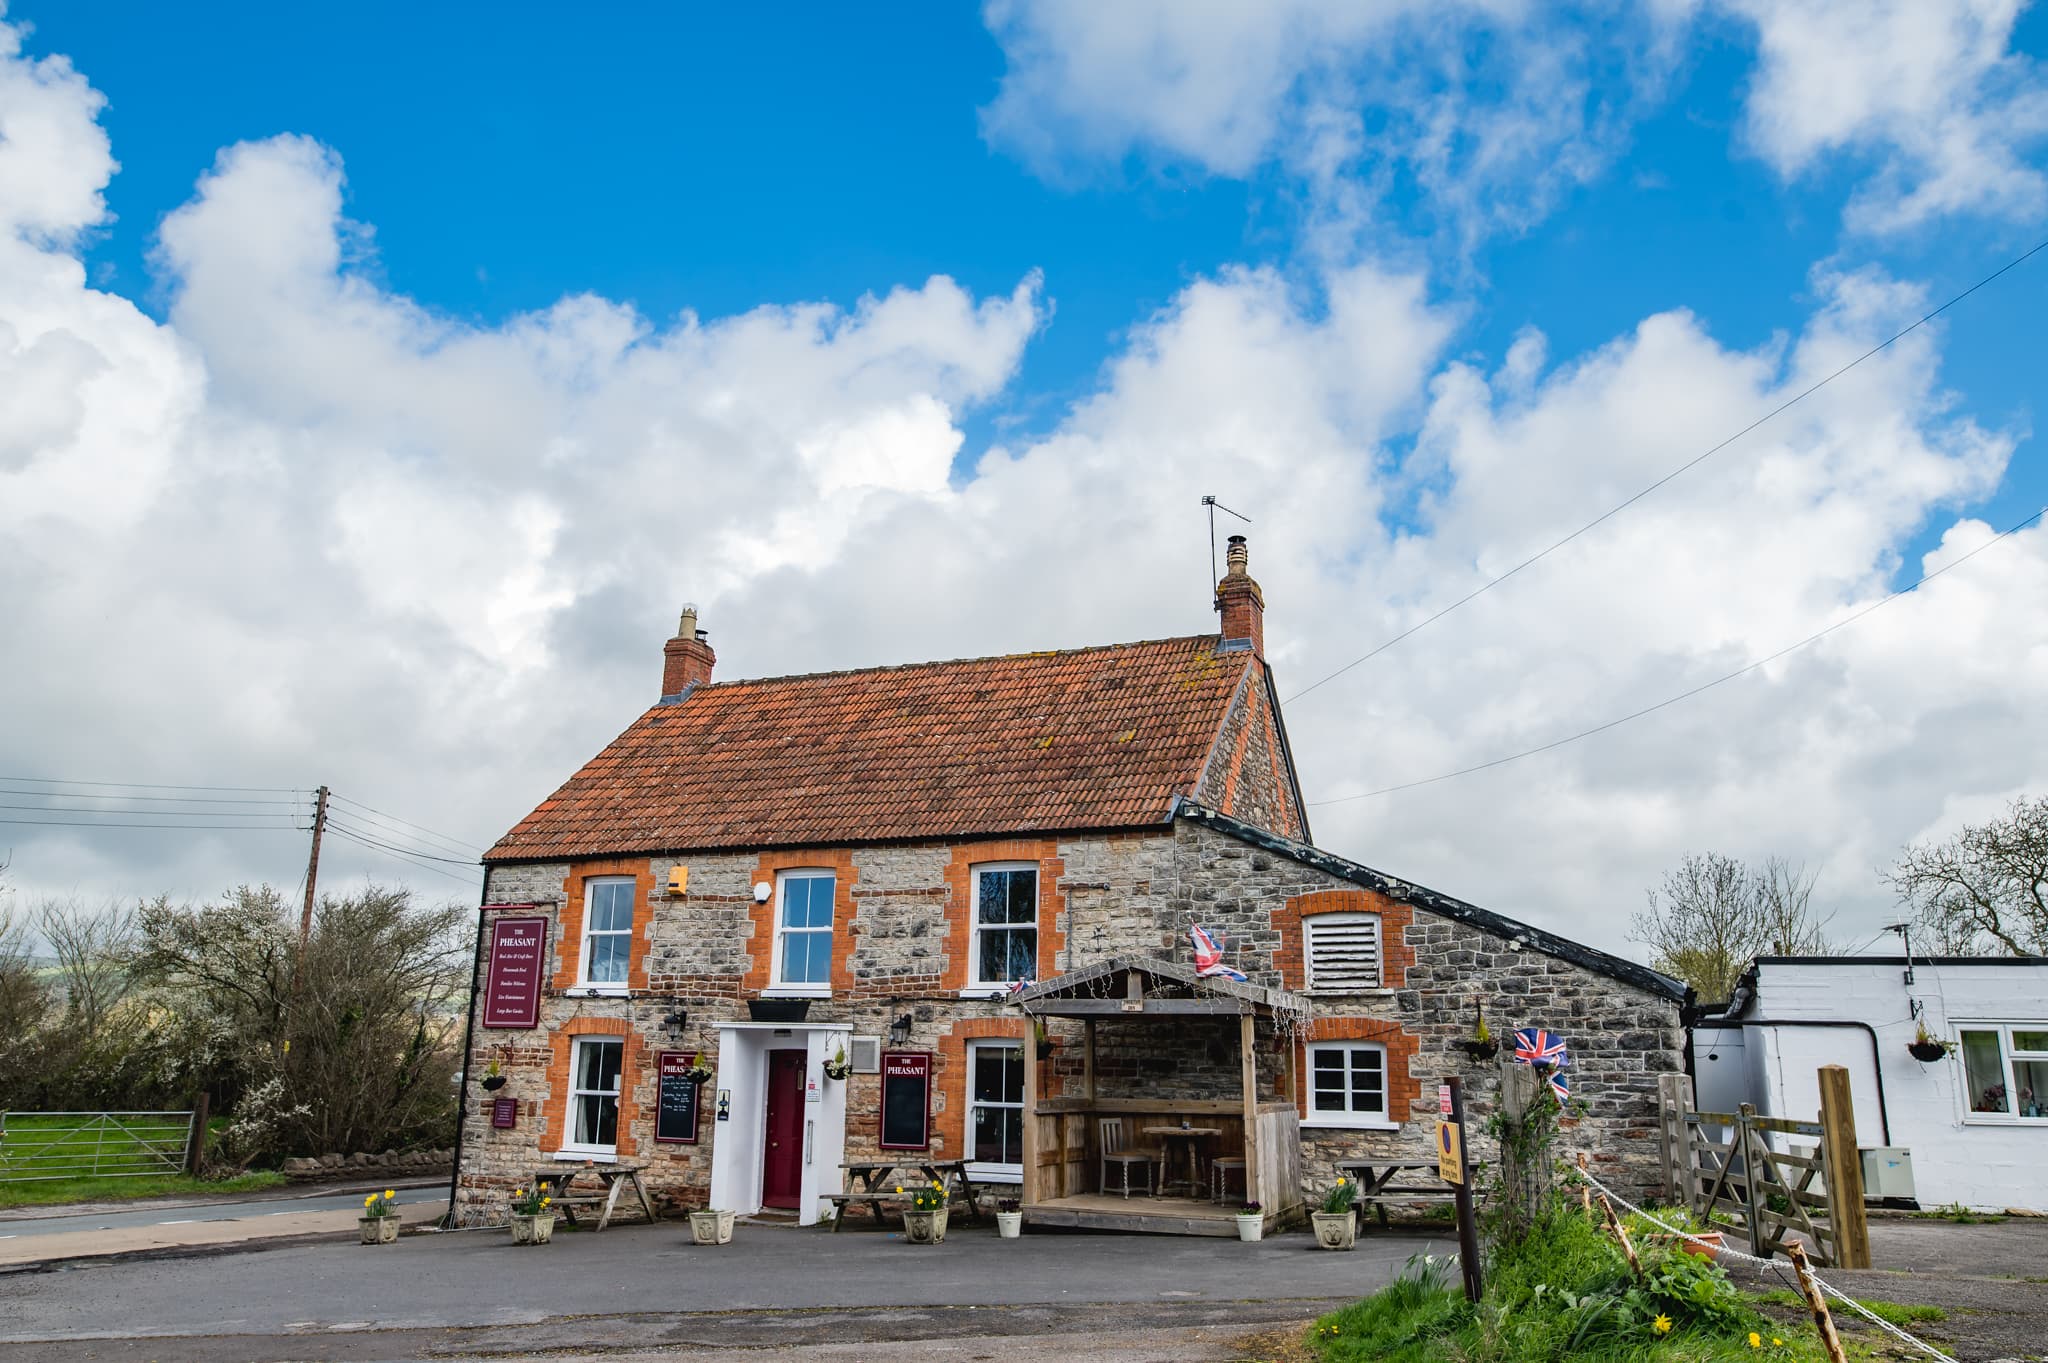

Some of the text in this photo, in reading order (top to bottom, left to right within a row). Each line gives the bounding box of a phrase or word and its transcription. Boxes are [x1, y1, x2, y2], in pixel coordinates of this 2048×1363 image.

[500, 937, 536, 947] PHEASANT
[664, 1065, 686, 1073] PHEAS
[887, 1066, 926, 1074] PHEASANT
